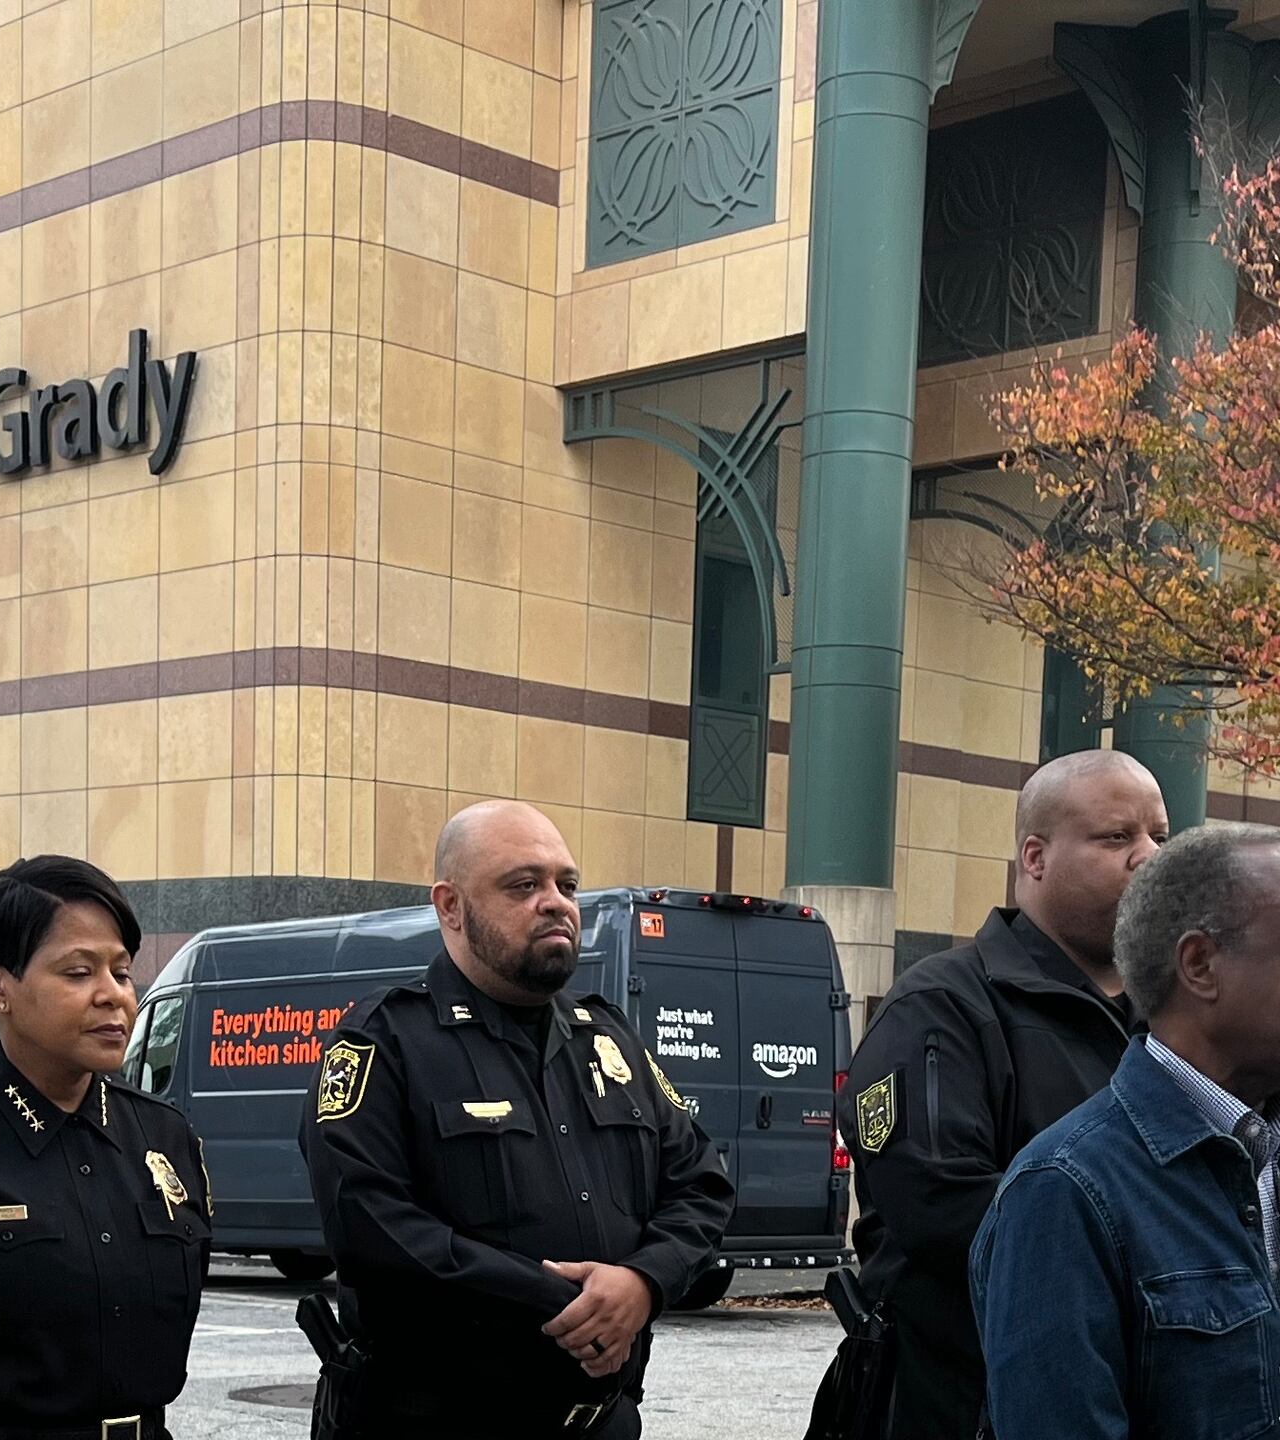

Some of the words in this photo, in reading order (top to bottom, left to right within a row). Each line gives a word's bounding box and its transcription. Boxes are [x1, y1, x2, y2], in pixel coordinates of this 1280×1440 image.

[212, 1004, 314, 1039] Everything
[656, 1006, 683, 1024] Just
[684, 1009, 713, 1025] what
[656, 1025, 694, 1041] you're
[210, 1038, 279, 1066] kitchen
[283, 1036, 322, 1064] sink
[657, 1041, 700, 1061] looking
[701, 1043, 721, 1059] for.
[753, 1043, 817, 1066] amazon
